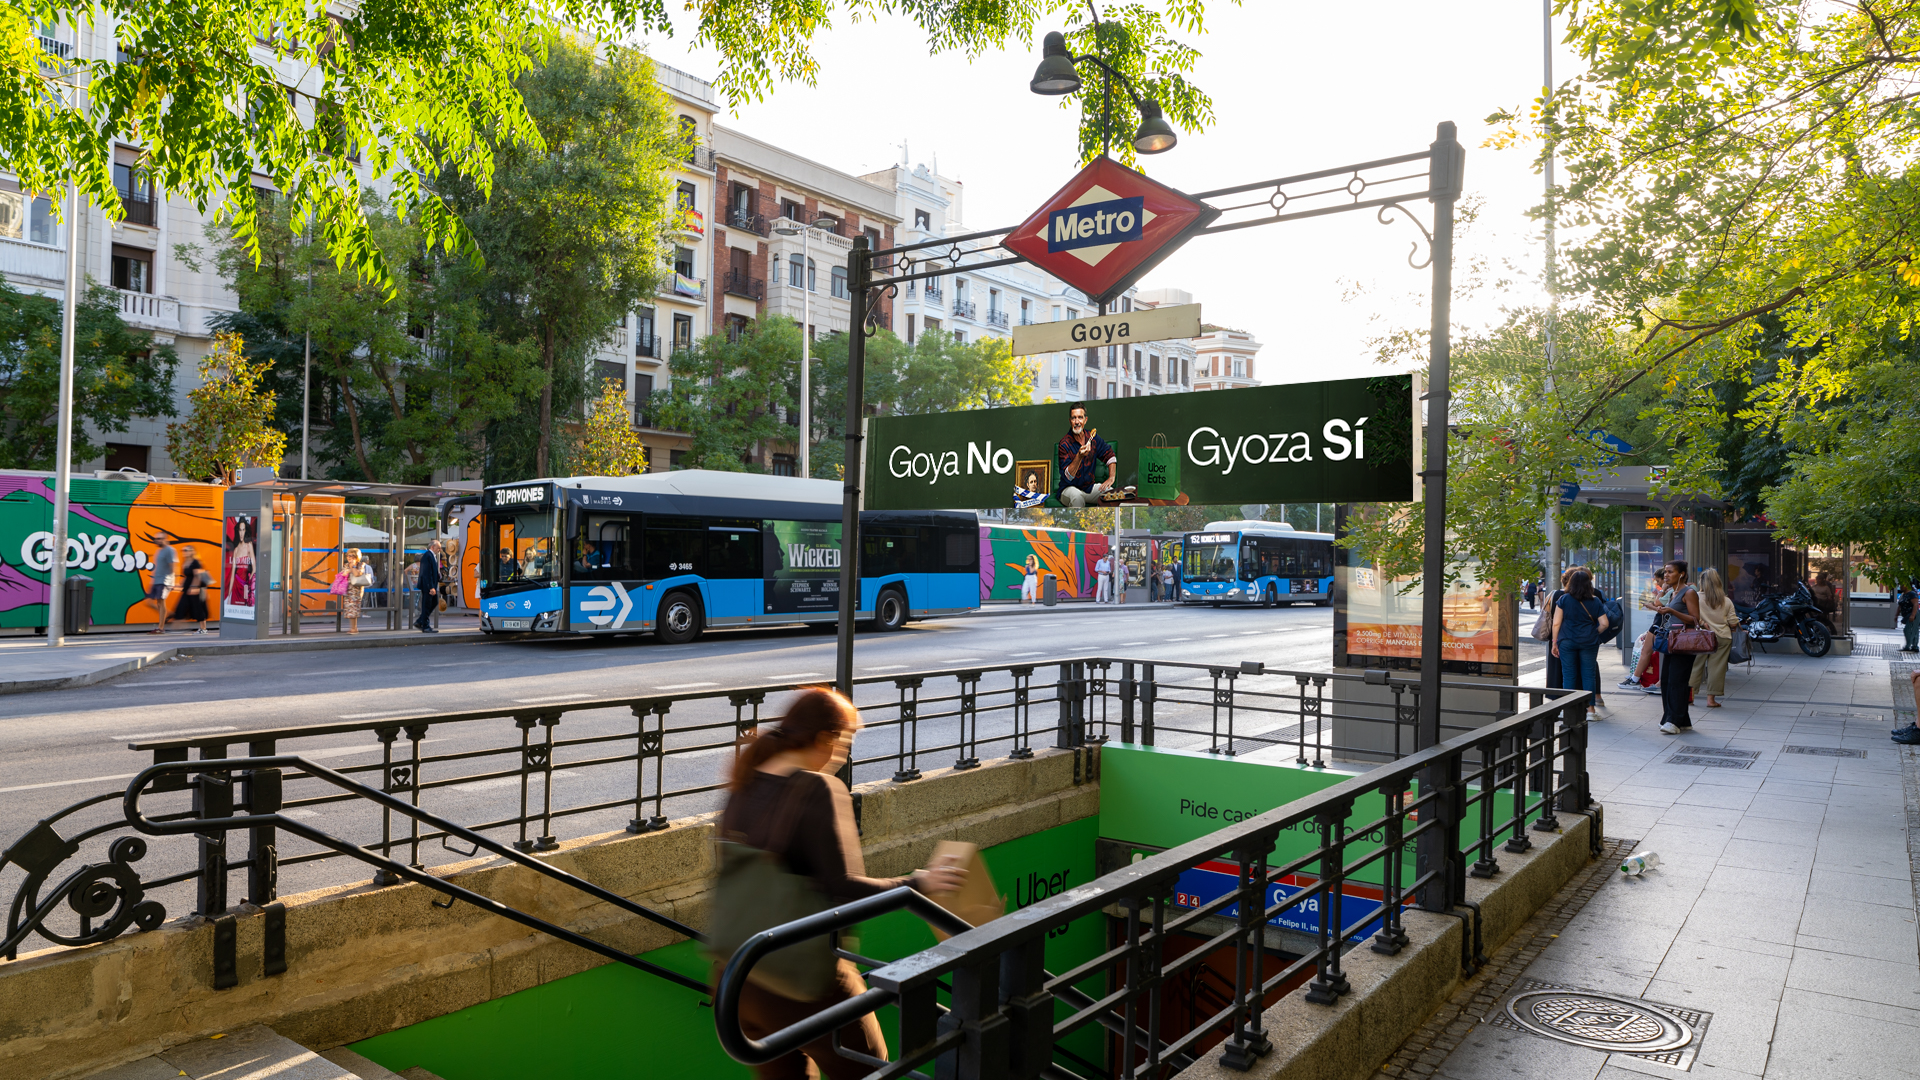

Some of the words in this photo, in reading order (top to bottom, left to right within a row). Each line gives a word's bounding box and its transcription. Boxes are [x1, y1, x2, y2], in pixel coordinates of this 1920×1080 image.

[1055, 210, 1135, 243] Metro
[1071, 321, 1130, 344] Goya
[1187, 426, 1313, 475] Gyoza
[1322, 416, 1369, 462] Sí
[888, 445, 960, 485] Goya
[966, 440, 1014, 475] No
[1147, 462, 1167, 473] Uber
[1147, 473, 1167, 485] Eats
[495, 489, 506, 506] 30
[506, 487, 544, 504] PAVONES
[678, 562, 693, 571] 3465
[1356, 637, 1384, 645] CORRIGE
[1385, 639, 1417, 647] MANCHAS
[1180, 798, 1218, 819] Pide
[1016, 868, 1070, 910] Uber
[1179, 893, 1187, 905] 2
[1190, 895, 1199, 907] 4
[1273, 888, 1319, 914] Gya
[1278, 917, 1300, 929] Felipe
[1565, 1014, 1626, 1026] Metro
